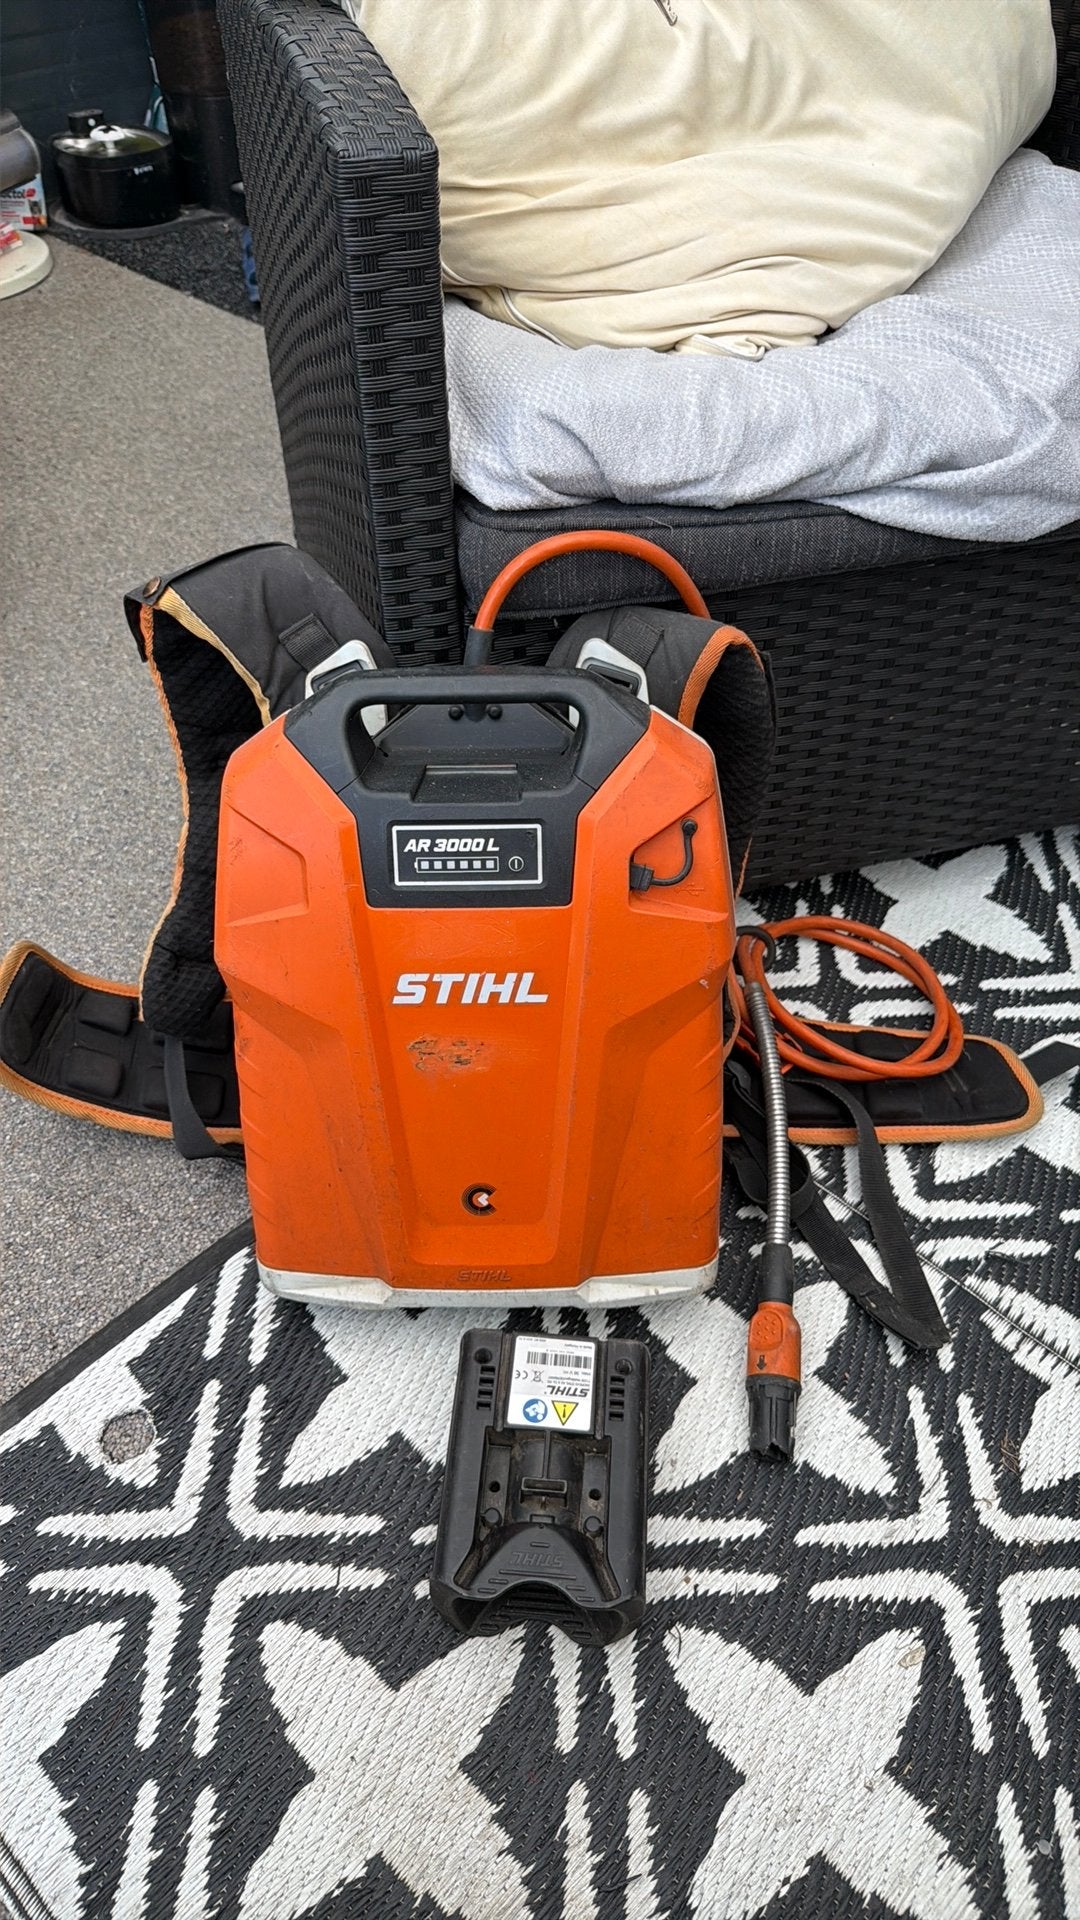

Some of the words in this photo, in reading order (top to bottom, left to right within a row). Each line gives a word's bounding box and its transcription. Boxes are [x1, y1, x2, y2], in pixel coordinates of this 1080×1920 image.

[404, 839, 431, 852] AR
[433, 838, 485, 852] 3000
[487, 838, 499, 851] L
[392, 972, 549, 1004] STIHL
[457, 1270, 512, 1281] STIHL
[547, 1385, 590, 1397] STIHL
[511, 1552, 564, 1568] STIHL
